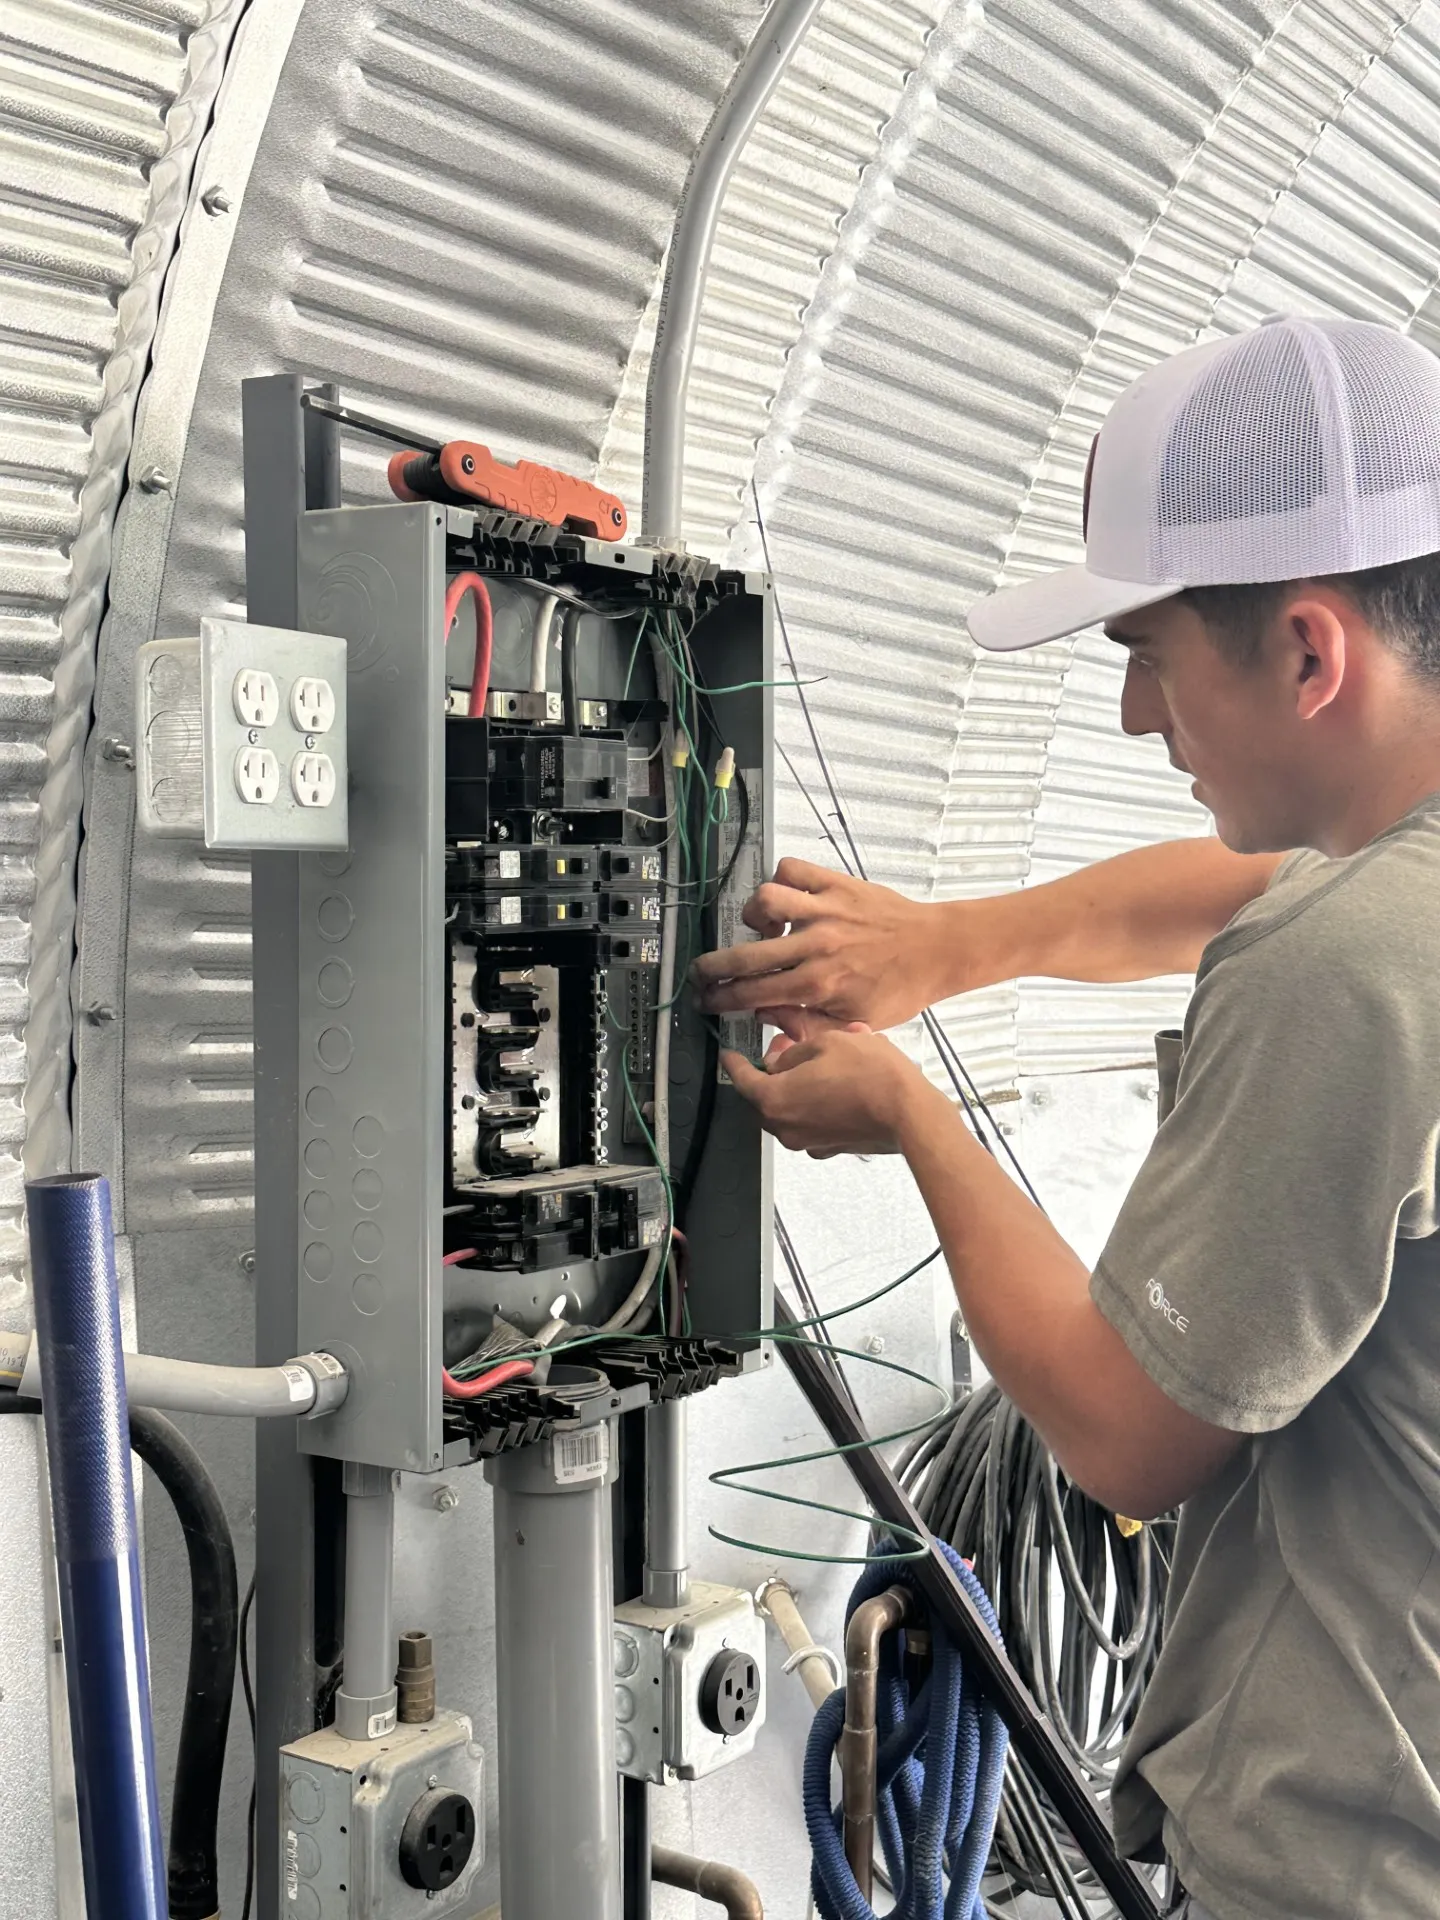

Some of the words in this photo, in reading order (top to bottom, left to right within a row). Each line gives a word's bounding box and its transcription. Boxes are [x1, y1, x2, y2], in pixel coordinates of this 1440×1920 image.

[659, 255, 676, 317] CONDUIT
[656, 319, 666, 348] MAX
[1145, 1278, 1190, 1334] FORCE
